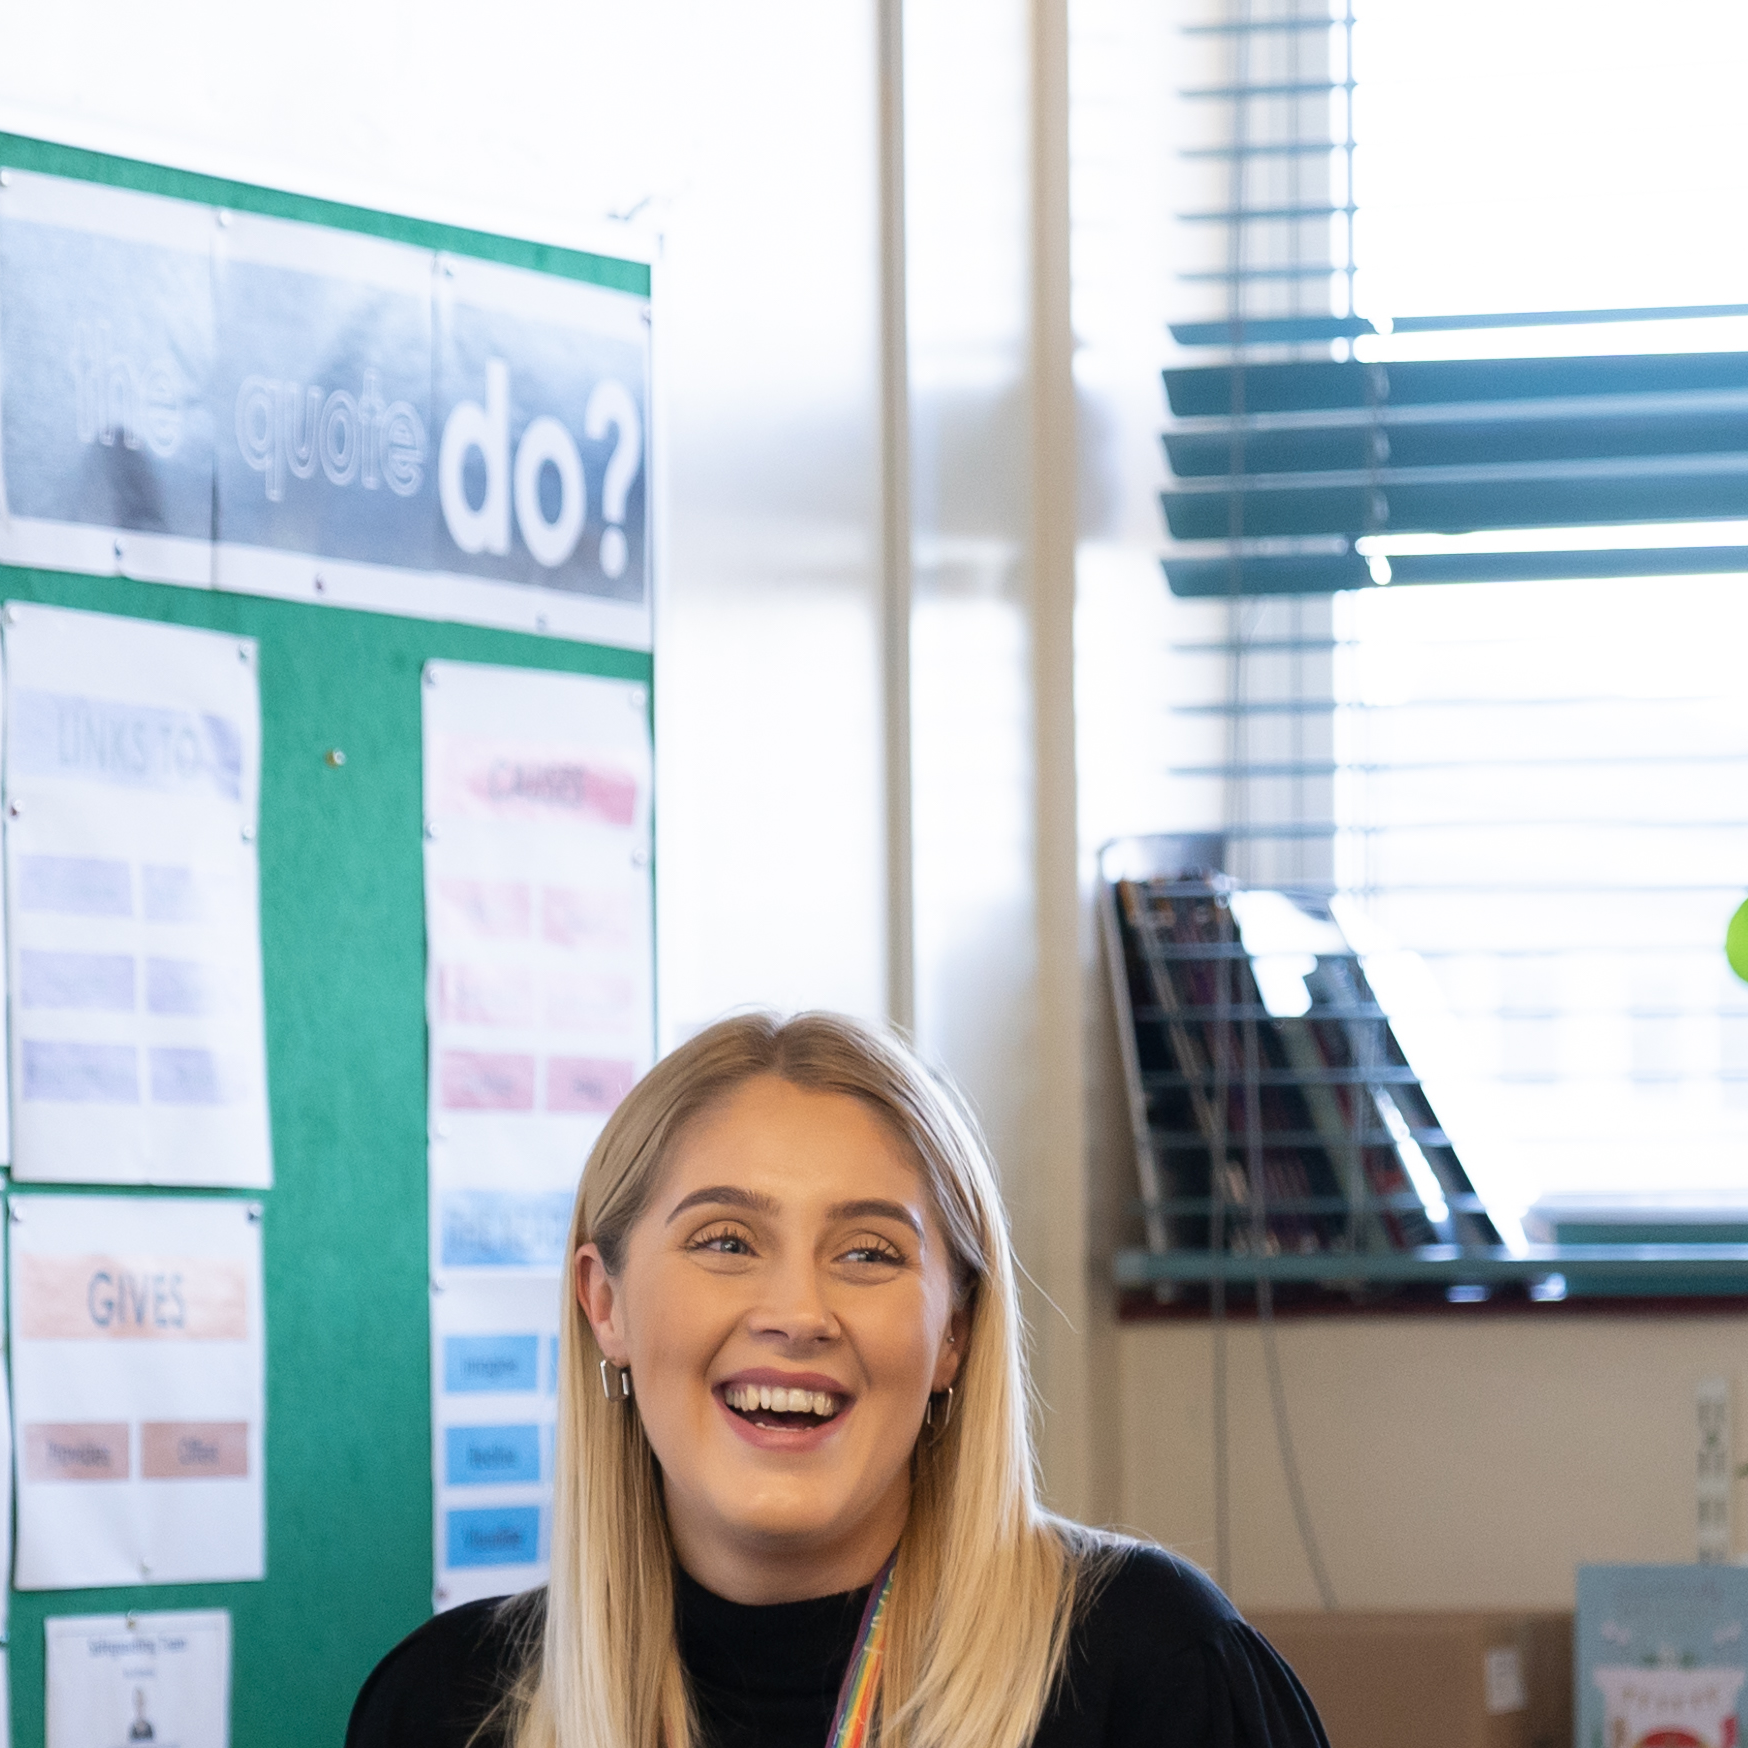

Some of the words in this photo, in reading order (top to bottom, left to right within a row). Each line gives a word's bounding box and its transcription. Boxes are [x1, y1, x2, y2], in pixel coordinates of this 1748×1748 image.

[235, 366, 428, 501] quote
[438, 356, 643, 579] do?
[86, 1269, 186, 1329] GIVES
